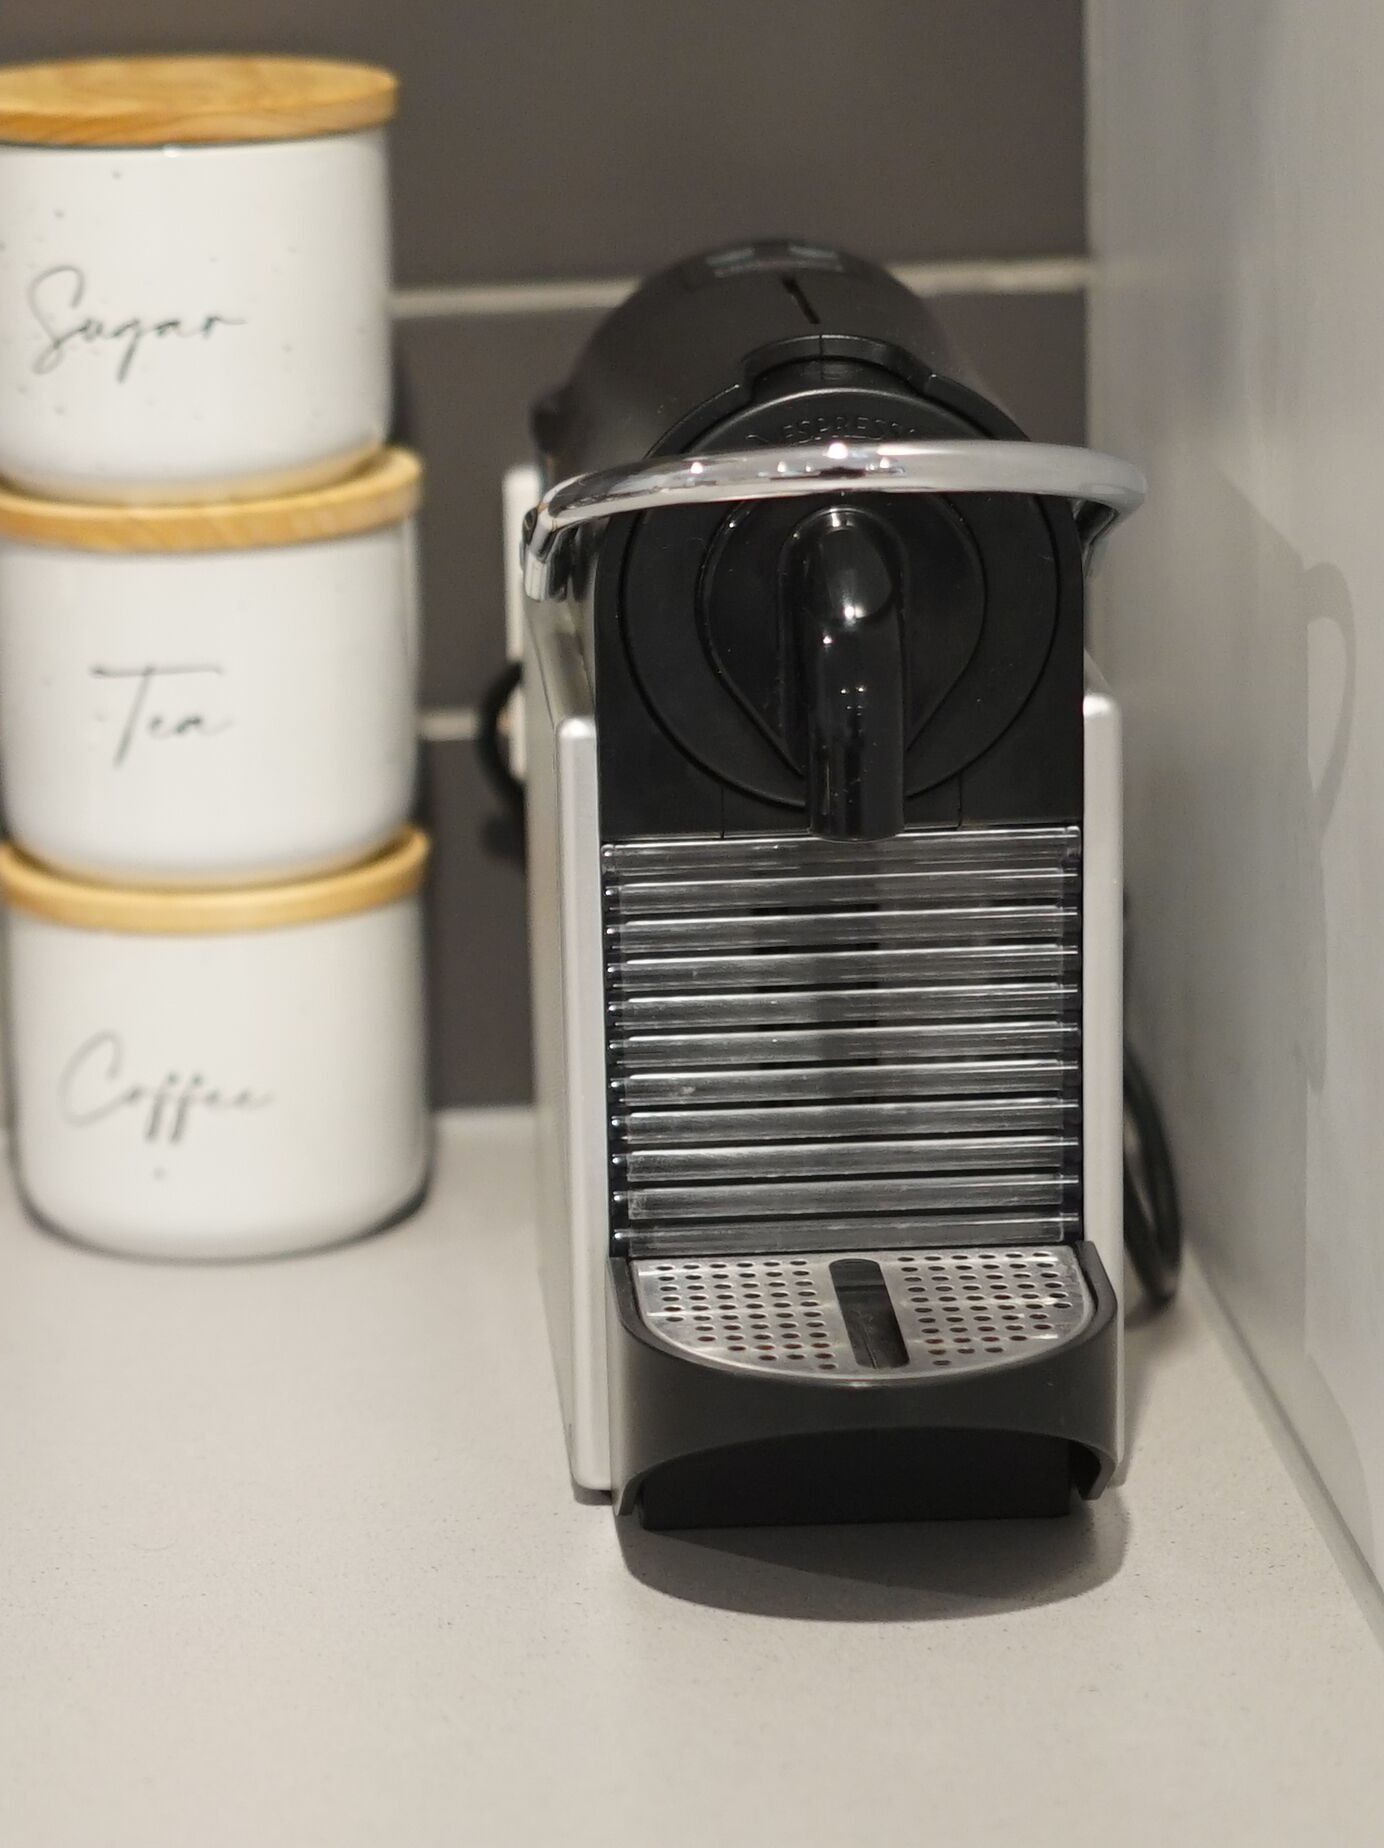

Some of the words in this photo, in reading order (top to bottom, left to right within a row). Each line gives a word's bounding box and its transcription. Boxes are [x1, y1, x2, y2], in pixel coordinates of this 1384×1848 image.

[26, 264, 248, 384] Sugar
[89, 662, 232, 769] Tea
[57, 1029, 273, 1142] Coffee
